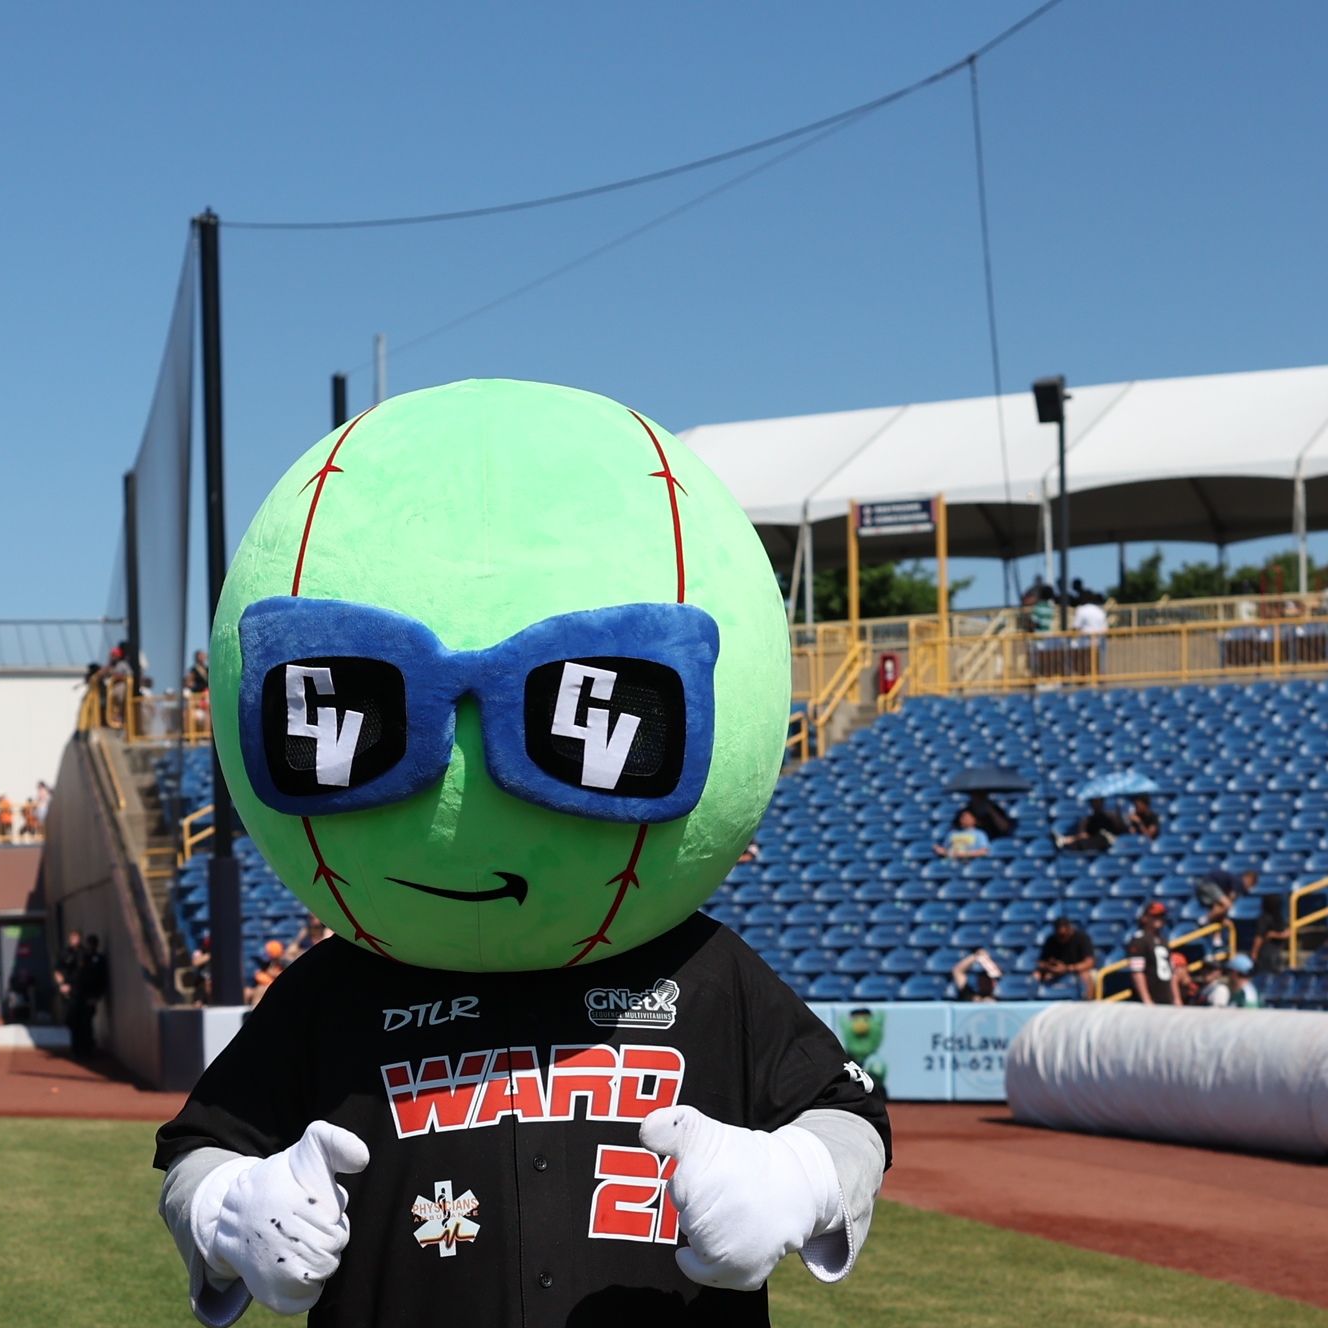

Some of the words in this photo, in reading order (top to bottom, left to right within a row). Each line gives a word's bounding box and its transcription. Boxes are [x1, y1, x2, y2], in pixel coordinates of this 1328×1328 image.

[588, 991, 671, 1011] GNetX
[382, 996, 480, 1031] DTLR
[624, 1012, 672, 1020] MULTIVITAMINS
[380, 1044, 685, 1139] WARD
[412, 1198, 478, 1215] PHYSICIANS
[413, 1210, 479, 1222] AMBULANCE
